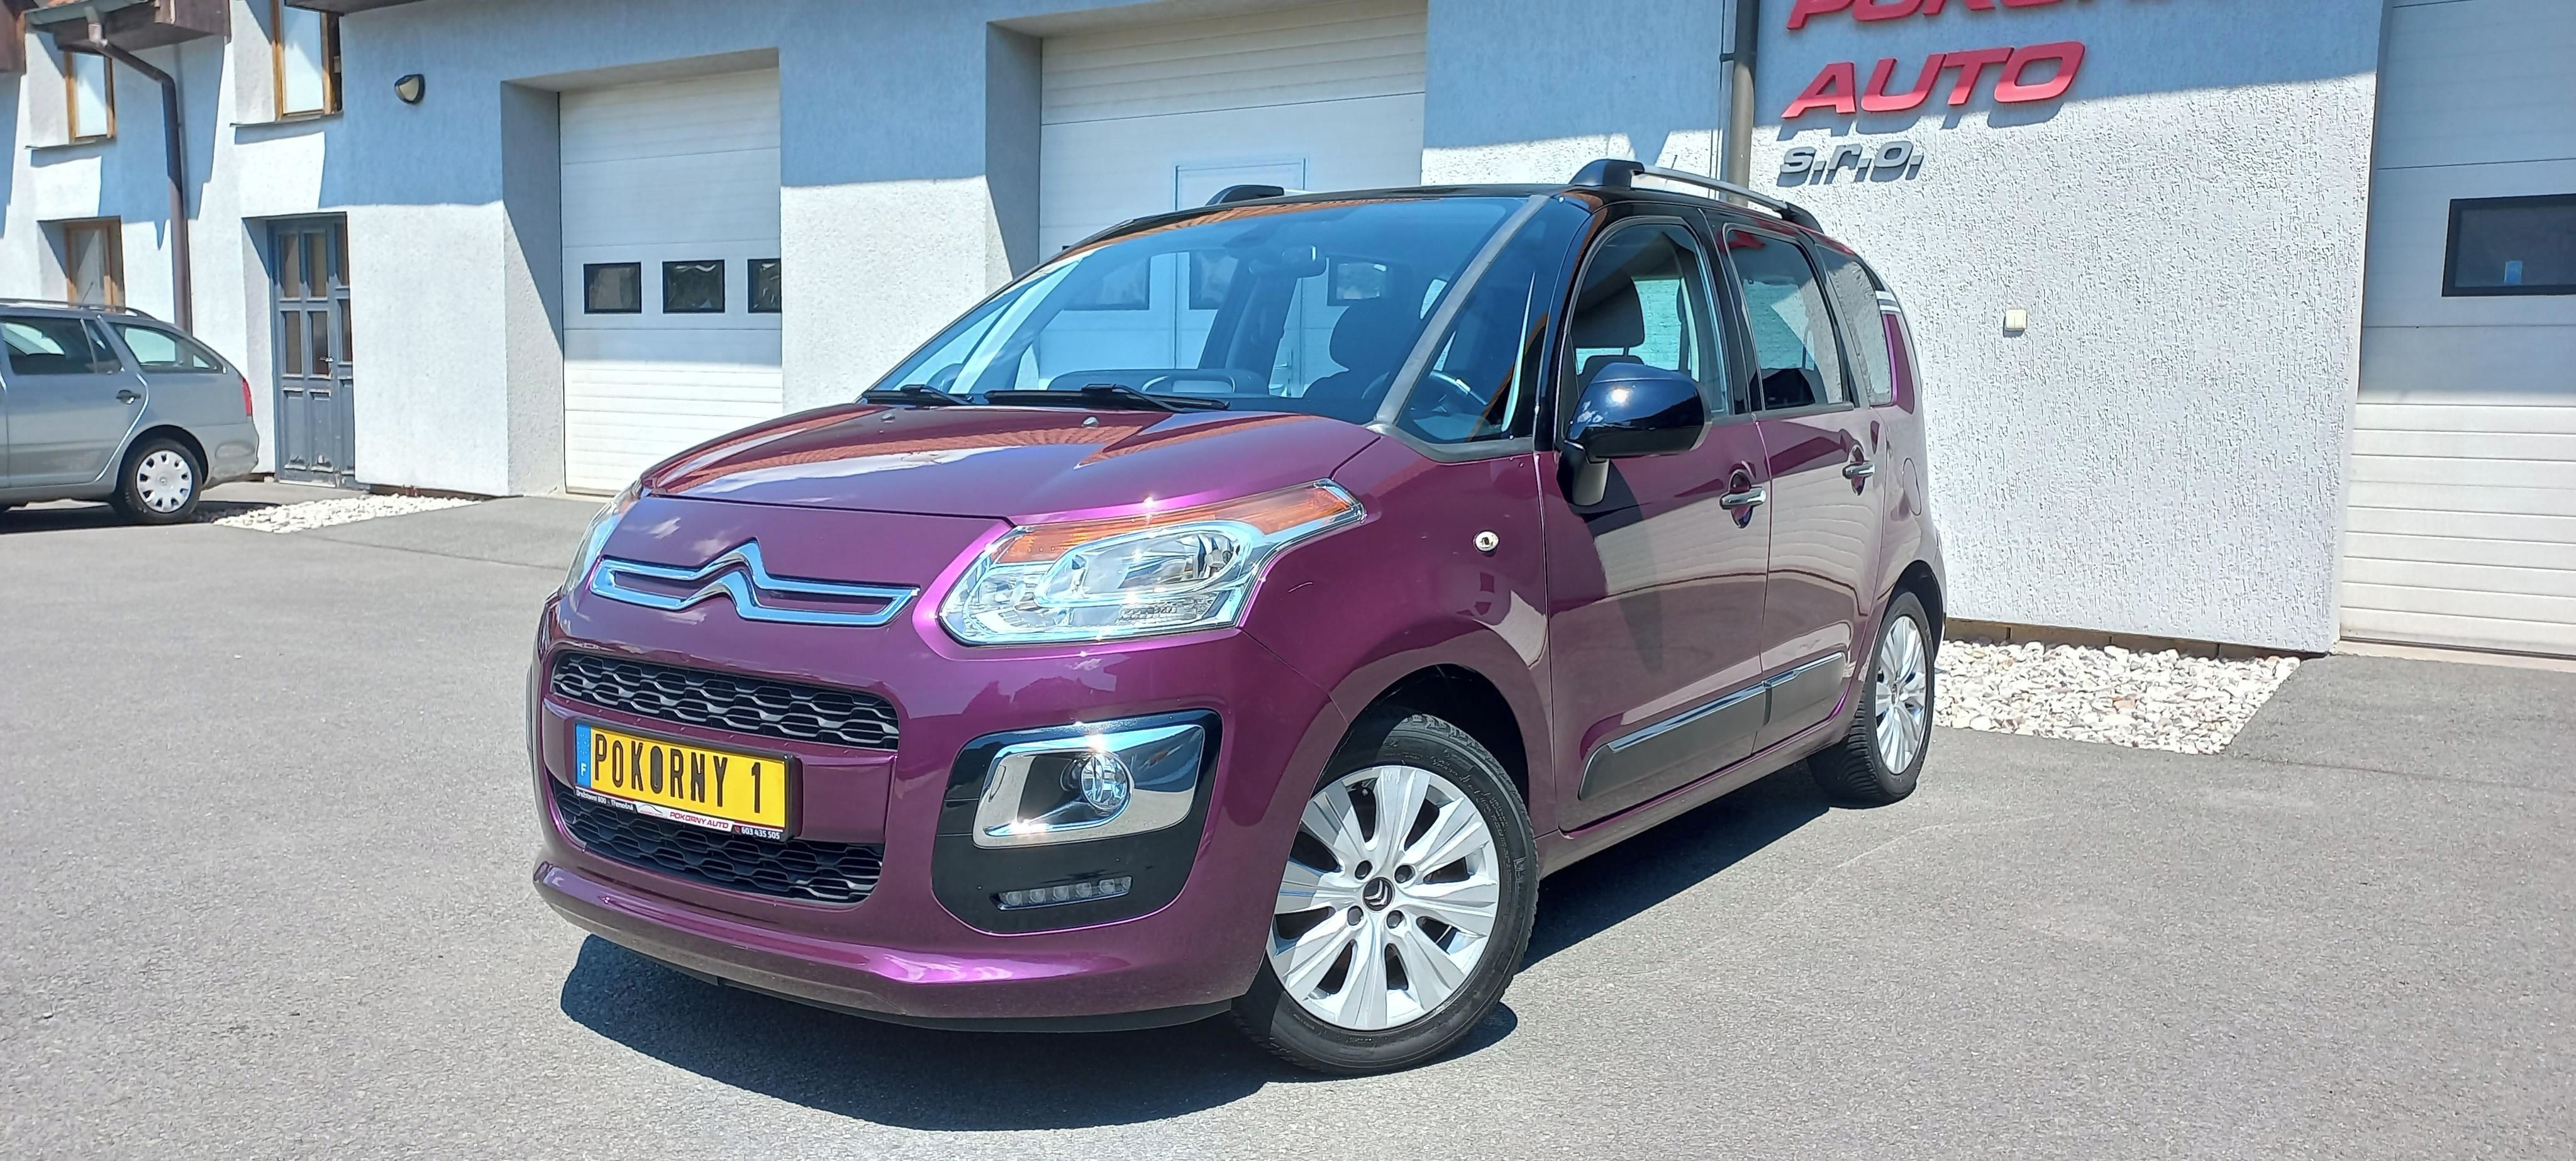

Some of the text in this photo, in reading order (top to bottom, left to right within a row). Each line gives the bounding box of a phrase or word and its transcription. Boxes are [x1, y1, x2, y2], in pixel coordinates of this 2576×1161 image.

[1781, 41, 2085, 118] AUTO
[1781, 140, 1923, 174] s.r.o.
[580, 762, 587, 776] F
[594, 734, 761, 813] POKORNY 1
[670, 811, 706, 825] POKORNY
[706, 819, 729, 829] AUTO
[741, 826, 780, 840] 603 435 505
